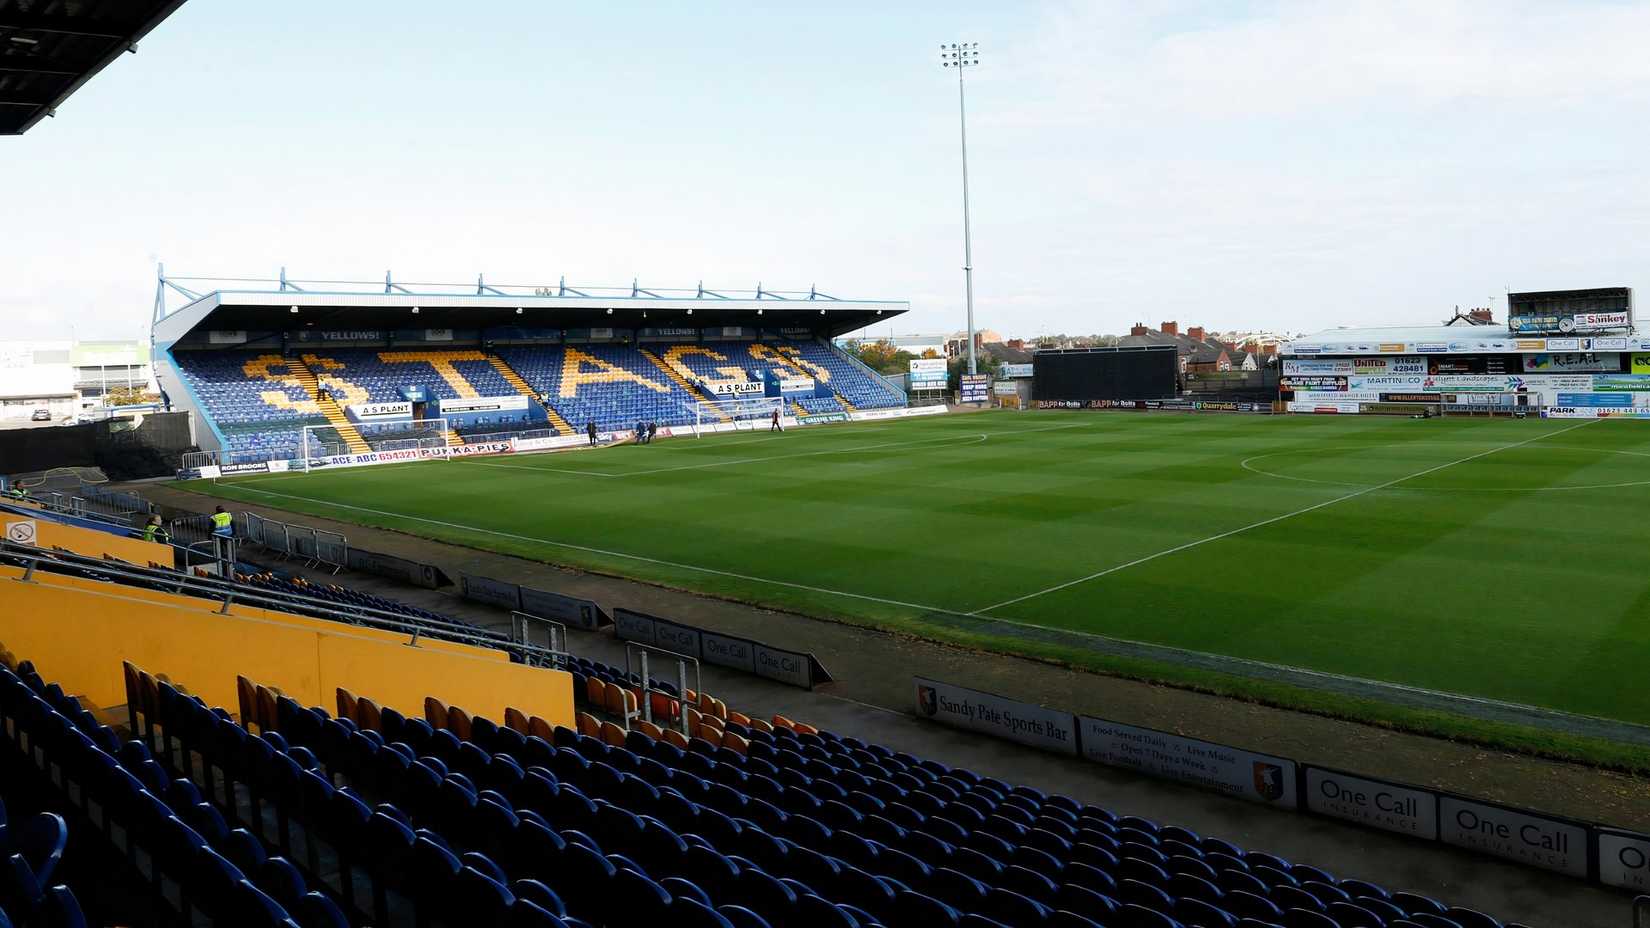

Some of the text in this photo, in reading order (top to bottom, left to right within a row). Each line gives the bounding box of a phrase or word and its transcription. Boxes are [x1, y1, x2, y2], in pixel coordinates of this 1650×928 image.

[321, 330, 381, 341] YELLOWS!
[1354, 359, 1386, 368] UNITED
[718, 383, 762, 393] A S PLANT
[1367, 377, 1401, 385] MARTIN
[1408, 376, 1421, 384] CO
[380, 404, 410, 413] PLANT
[331, 450, 417, 466] ACE-ABC 654321
[706, 639, 746, 658] One Call
[759, 651, 801, 673] One Call
[939, 695, 1068, 741] Sandy Pate Sports Bar
[1092, 725, 1236, 764] Food Served Daily Live Music
[1120, 743, 1143, 758] Open
[1152, 749, 1173, 764] Days
[1181, 754, 1205, 771] Week
[1320, 778, 1417, 819] One Call
[1319, 798, 1418, 832] INSURANCE
[1455, 809, 1568, 854] One Call
[1457, 831, 1569, 868] INSURANCE
[1618, 845, 1650, 871] O
